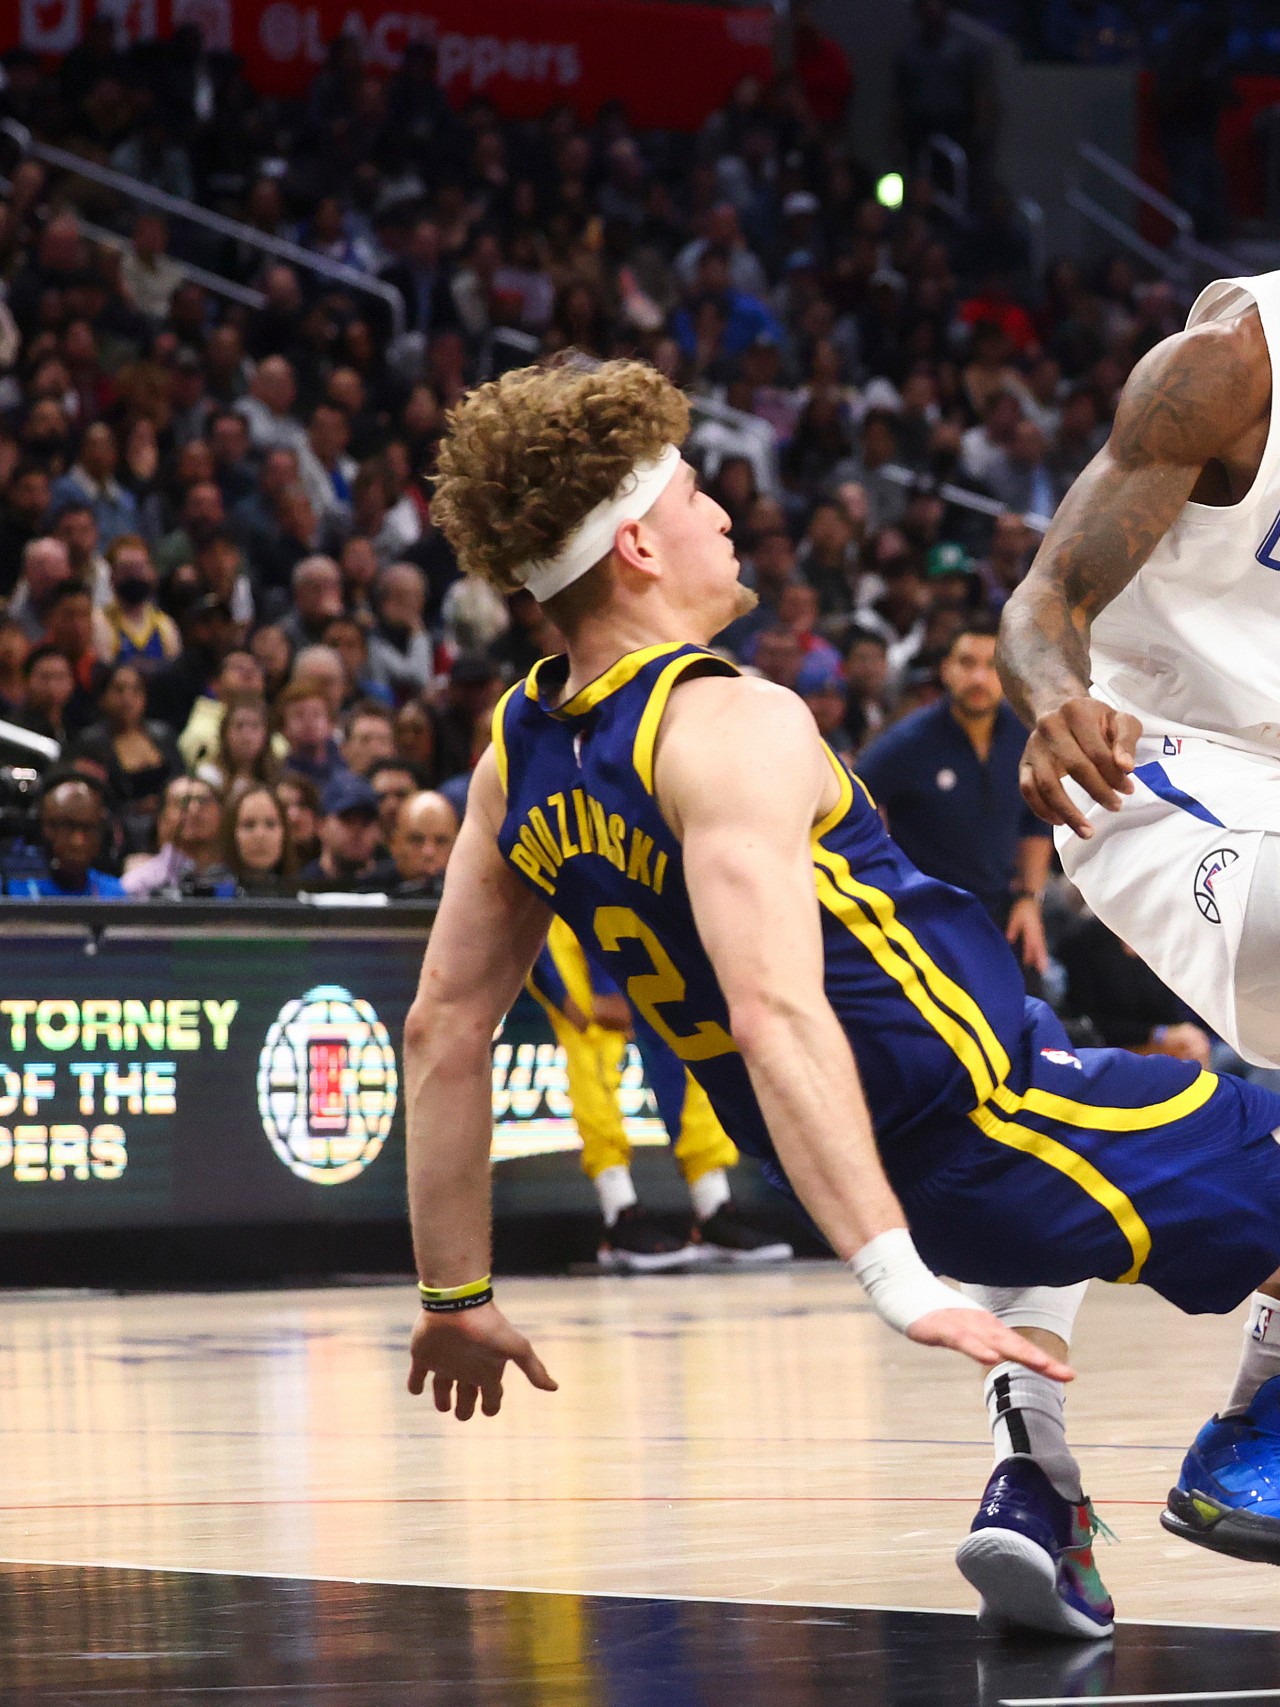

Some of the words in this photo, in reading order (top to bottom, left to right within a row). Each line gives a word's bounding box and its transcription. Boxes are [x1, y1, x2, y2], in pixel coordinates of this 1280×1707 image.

[258, 1, 582, 89] @LACppers
[593, 905, 740, 1062] 2
[0, 999, 239, 1051] TORNEY
[69, 1061, 177, 1116] THE
